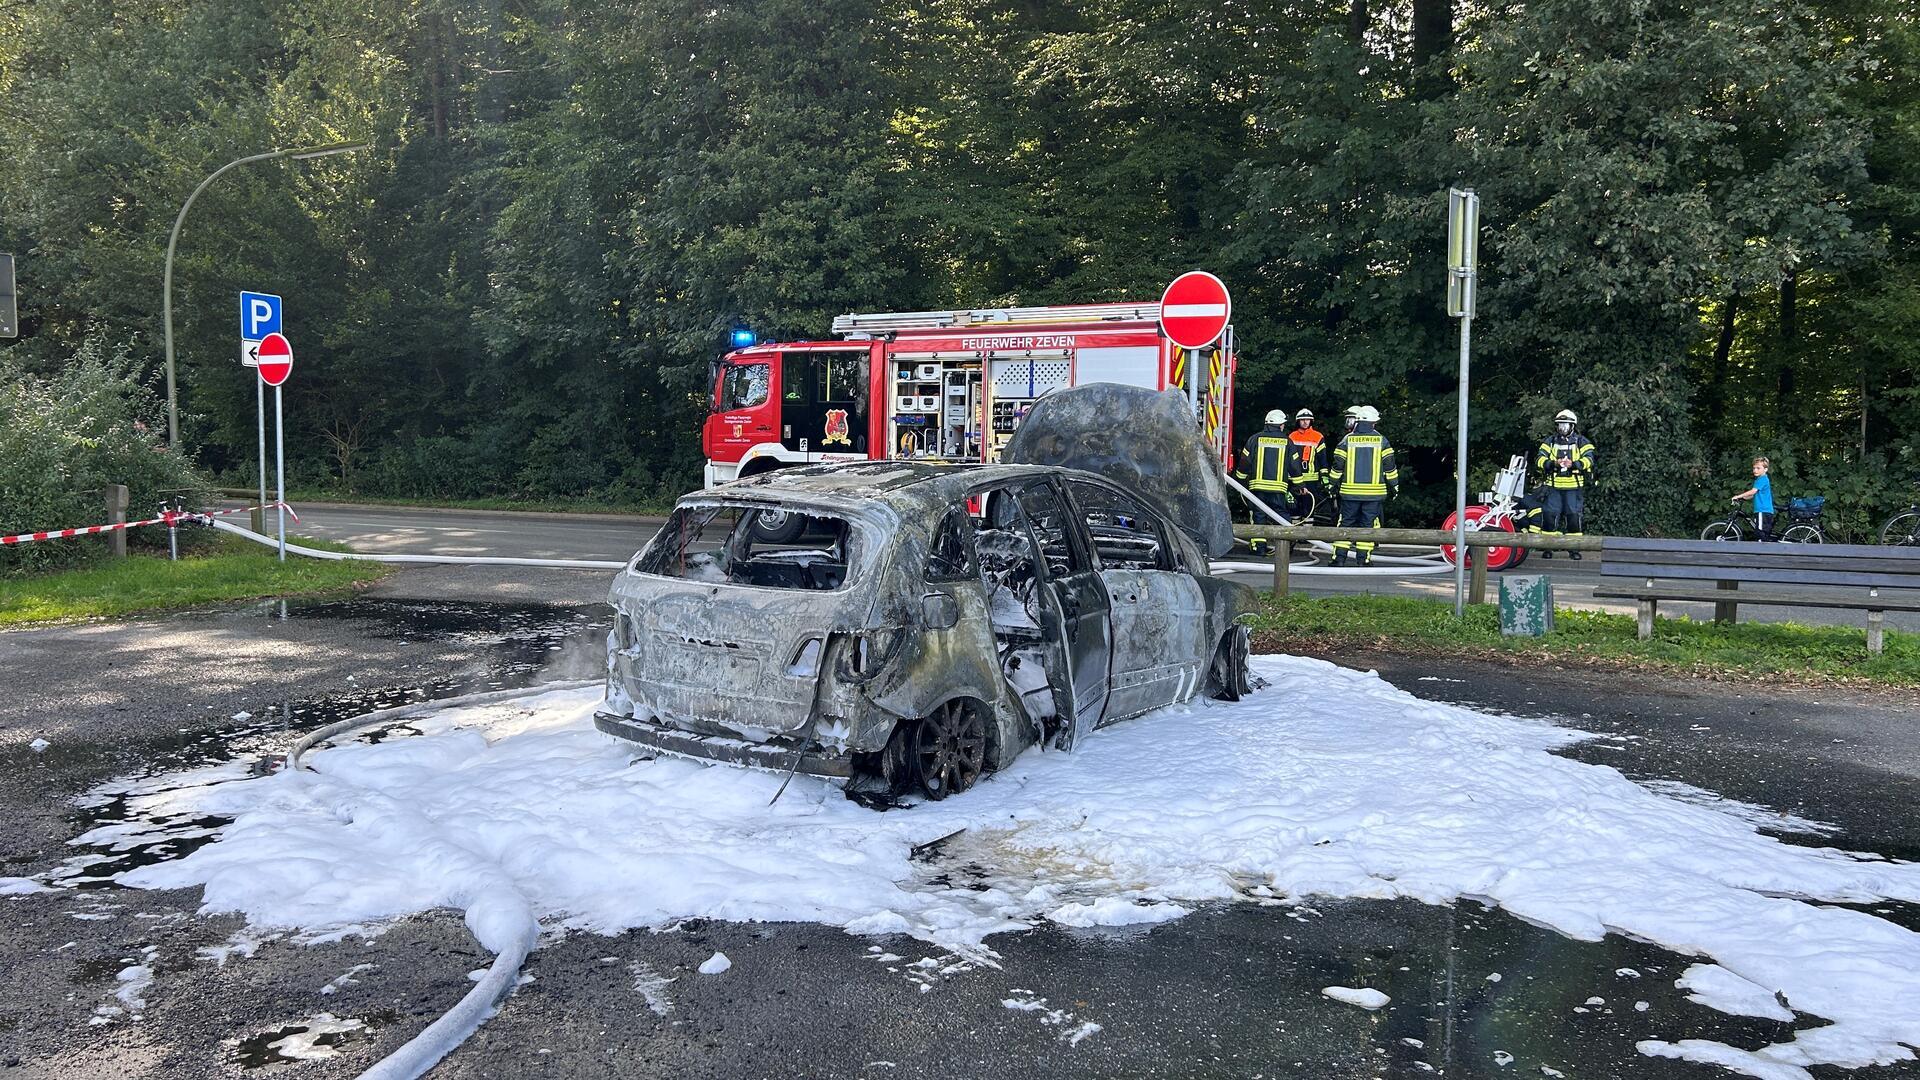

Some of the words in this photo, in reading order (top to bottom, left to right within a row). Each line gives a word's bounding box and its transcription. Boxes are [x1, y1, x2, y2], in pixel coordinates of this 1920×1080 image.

[251, 299, 272, 335] P
[962, 337, 1033, 349] FEUERWEHR
[1036, 336, 1075, 347] ZEVEN
